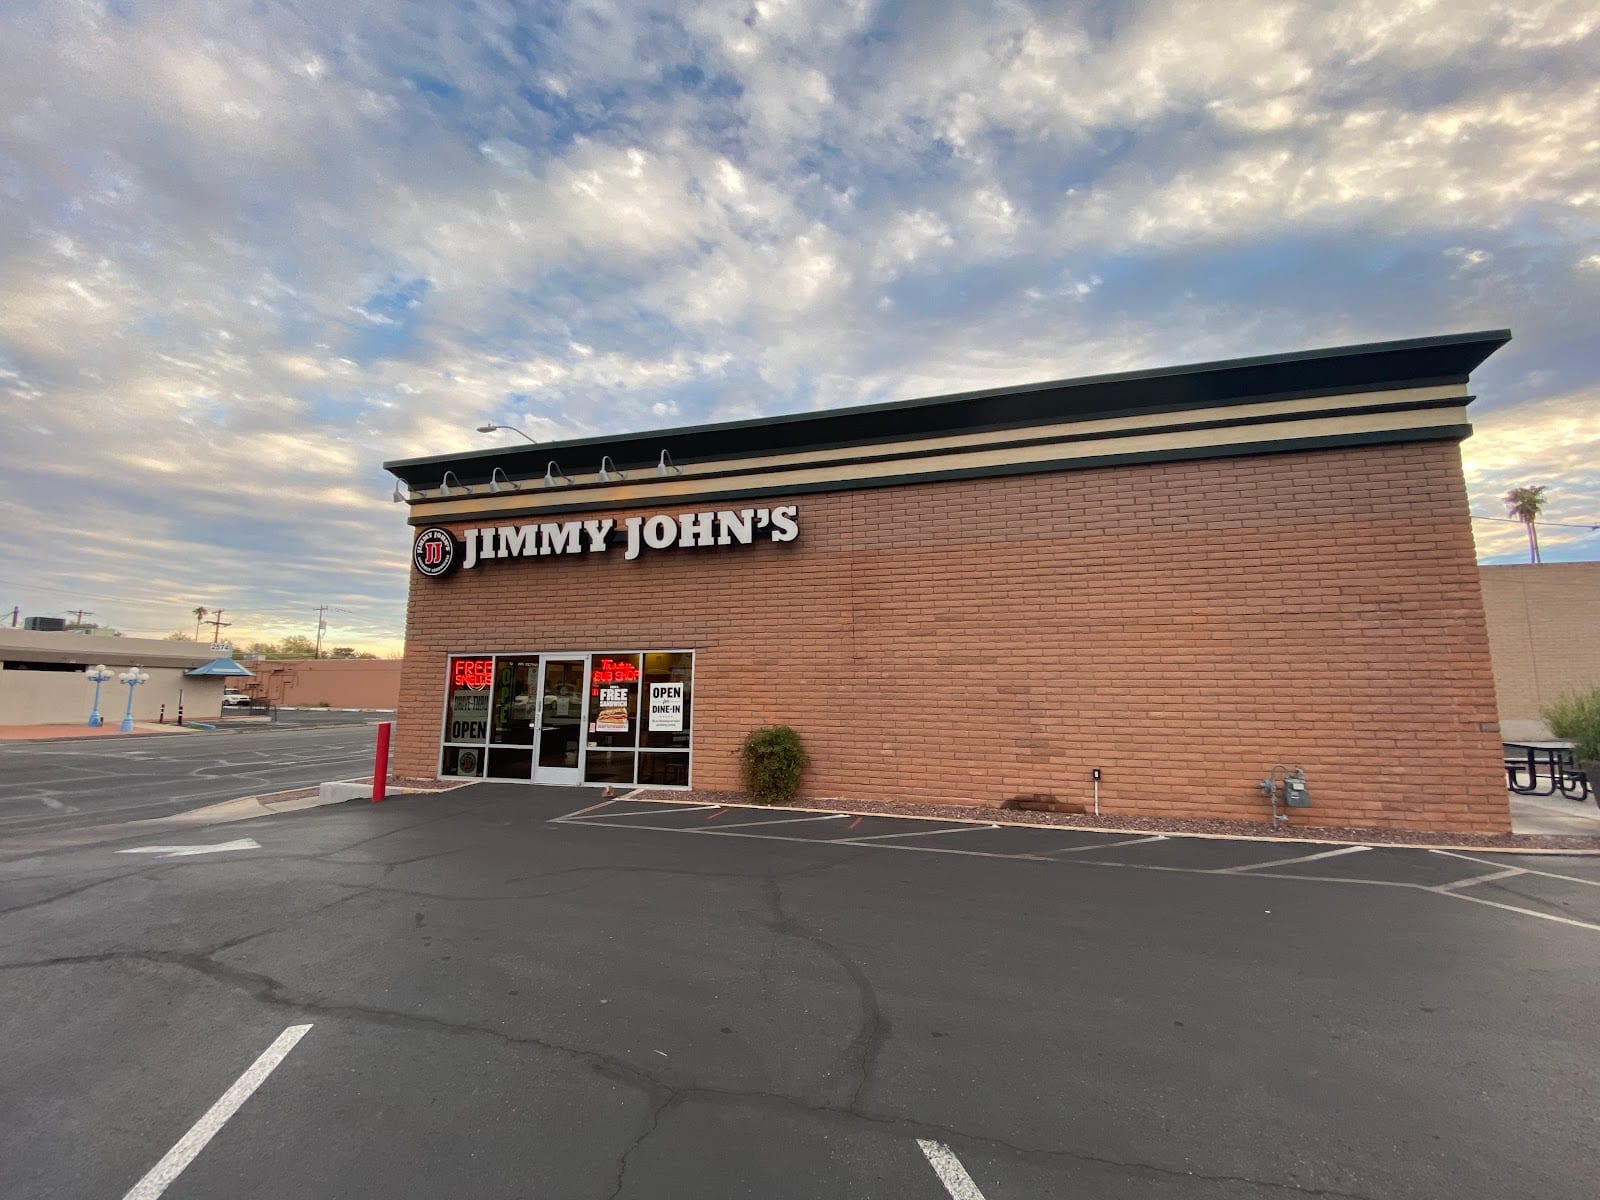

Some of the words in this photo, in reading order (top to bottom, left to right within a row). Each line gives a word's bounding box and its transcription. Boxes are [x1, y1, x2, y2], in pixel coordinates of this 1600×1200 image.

[462, 519, 614, 569] JIMMY
[624, 505, 799, 560] JOHN'S
[425, 541, 442, 564] JJ
[455, 660, 493, 675] FREE
[594, 671, 613, 682] SUB
[600, 688, 628, 701] FREE
[653, 687, 681, 698] OPEN
[652, 705, 680, 713] DINE-IN
[452, 720, 486, 739] OPEN
